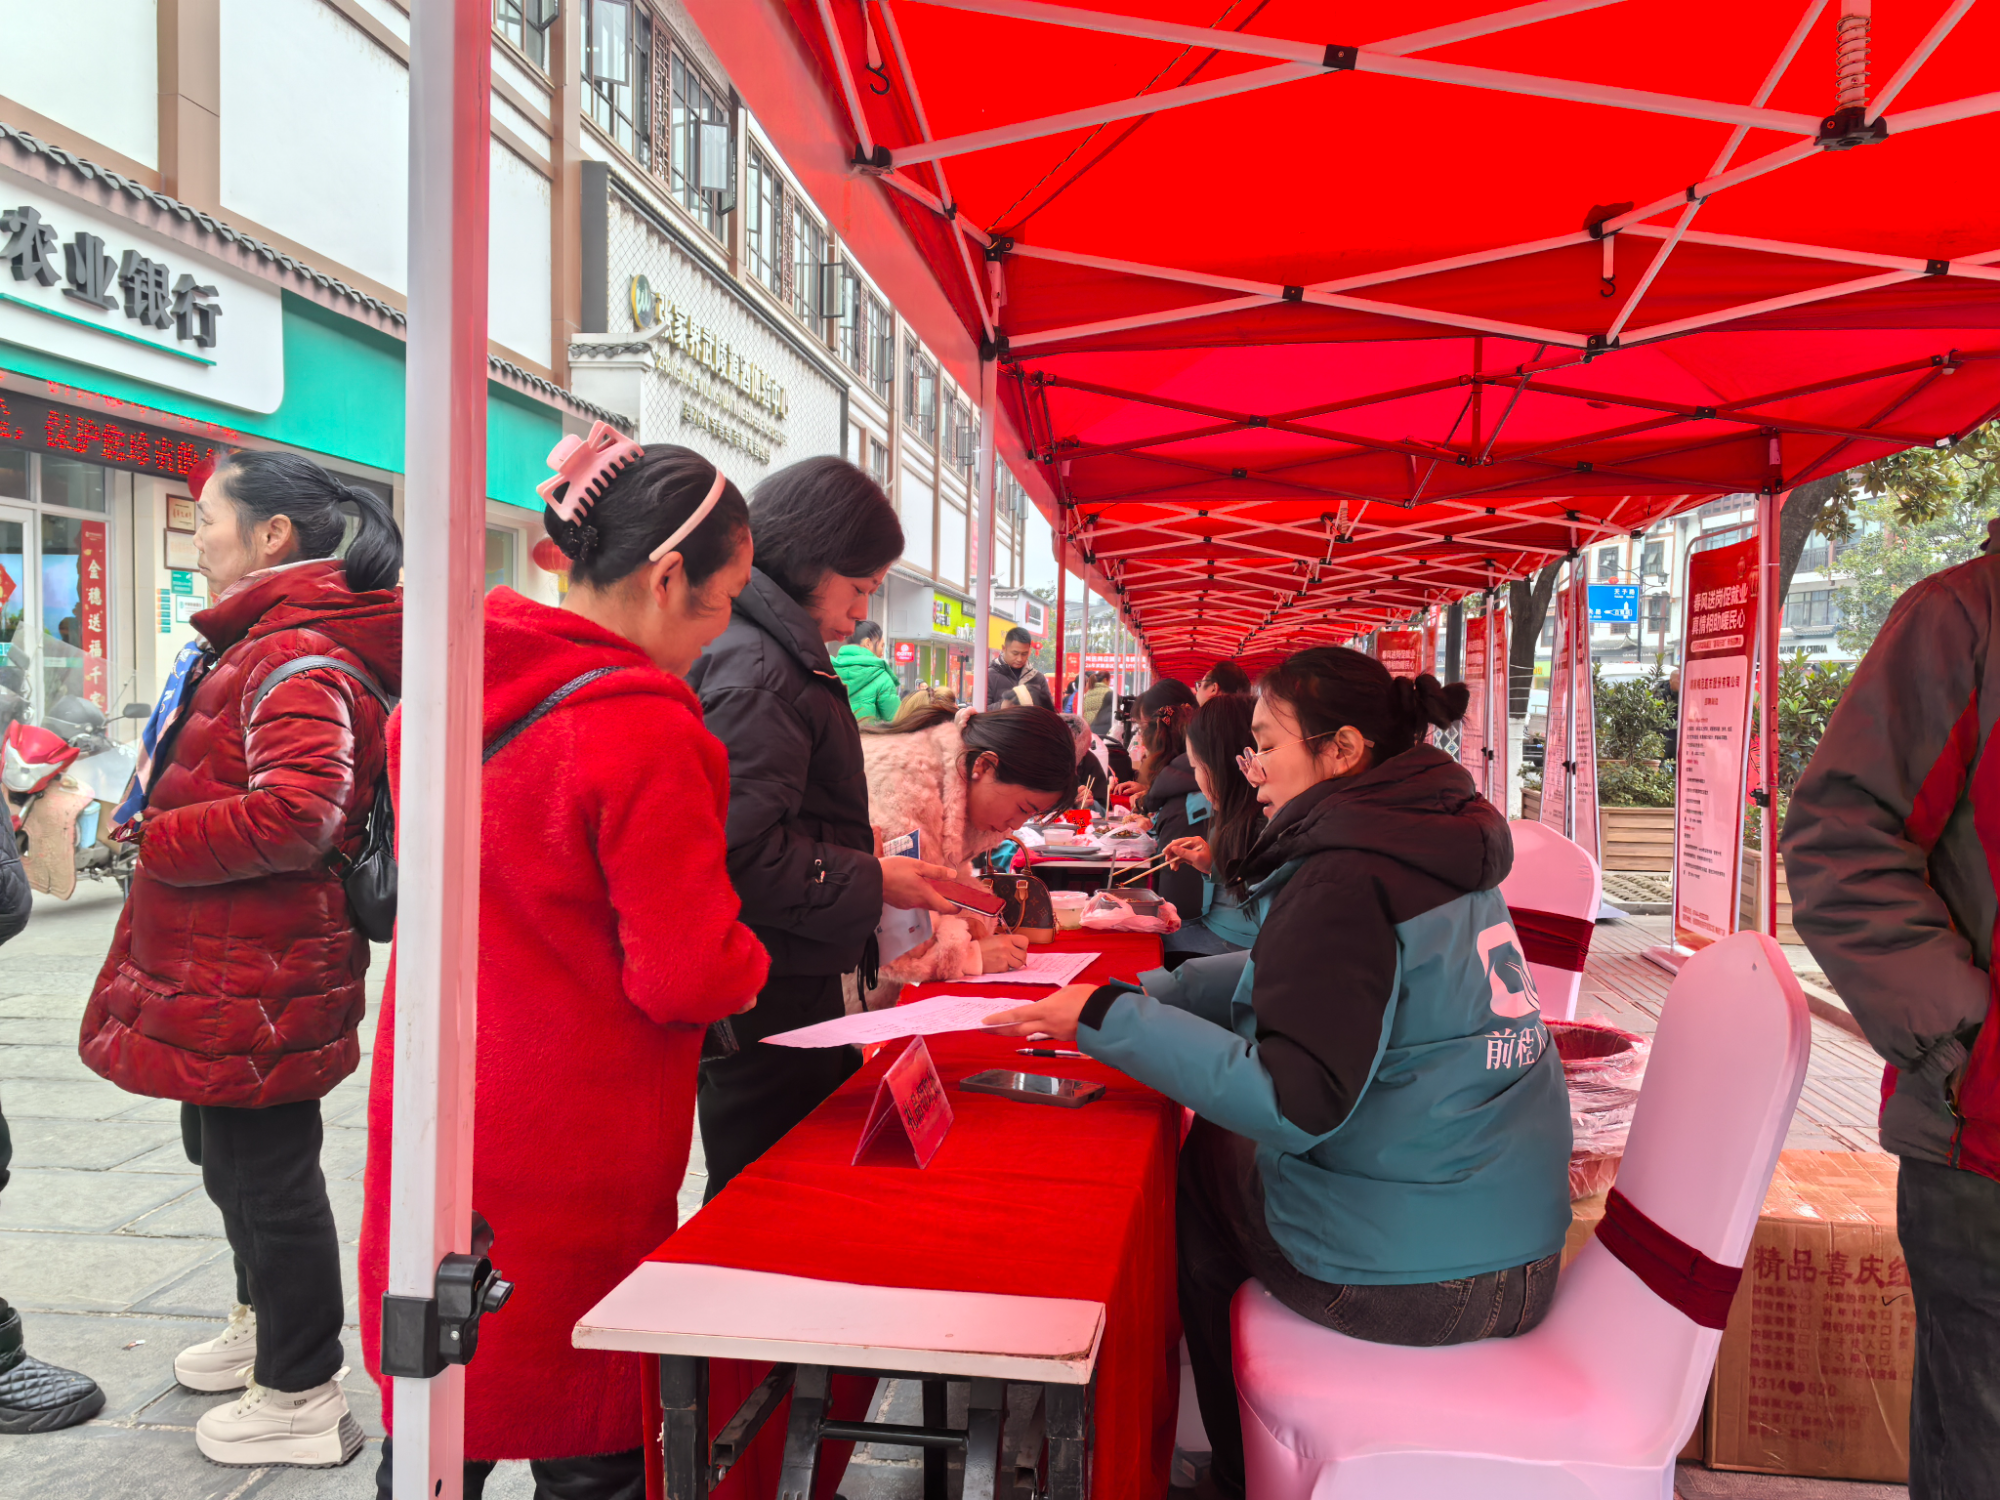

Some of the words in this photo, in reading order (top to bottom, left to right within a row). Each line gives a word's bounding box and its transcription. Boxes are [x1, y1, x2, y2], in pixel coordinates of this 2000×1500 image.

[0, 206, 222, 348] 农业银行
[1694, 583, 1748, 612] 春风送岗促就业
[87, 559, 103, 710] 金穗送福千家
[1692, 609, 1746, 635] 真情相助暖民心
[1806, 644, 1828, 654] CHINA
